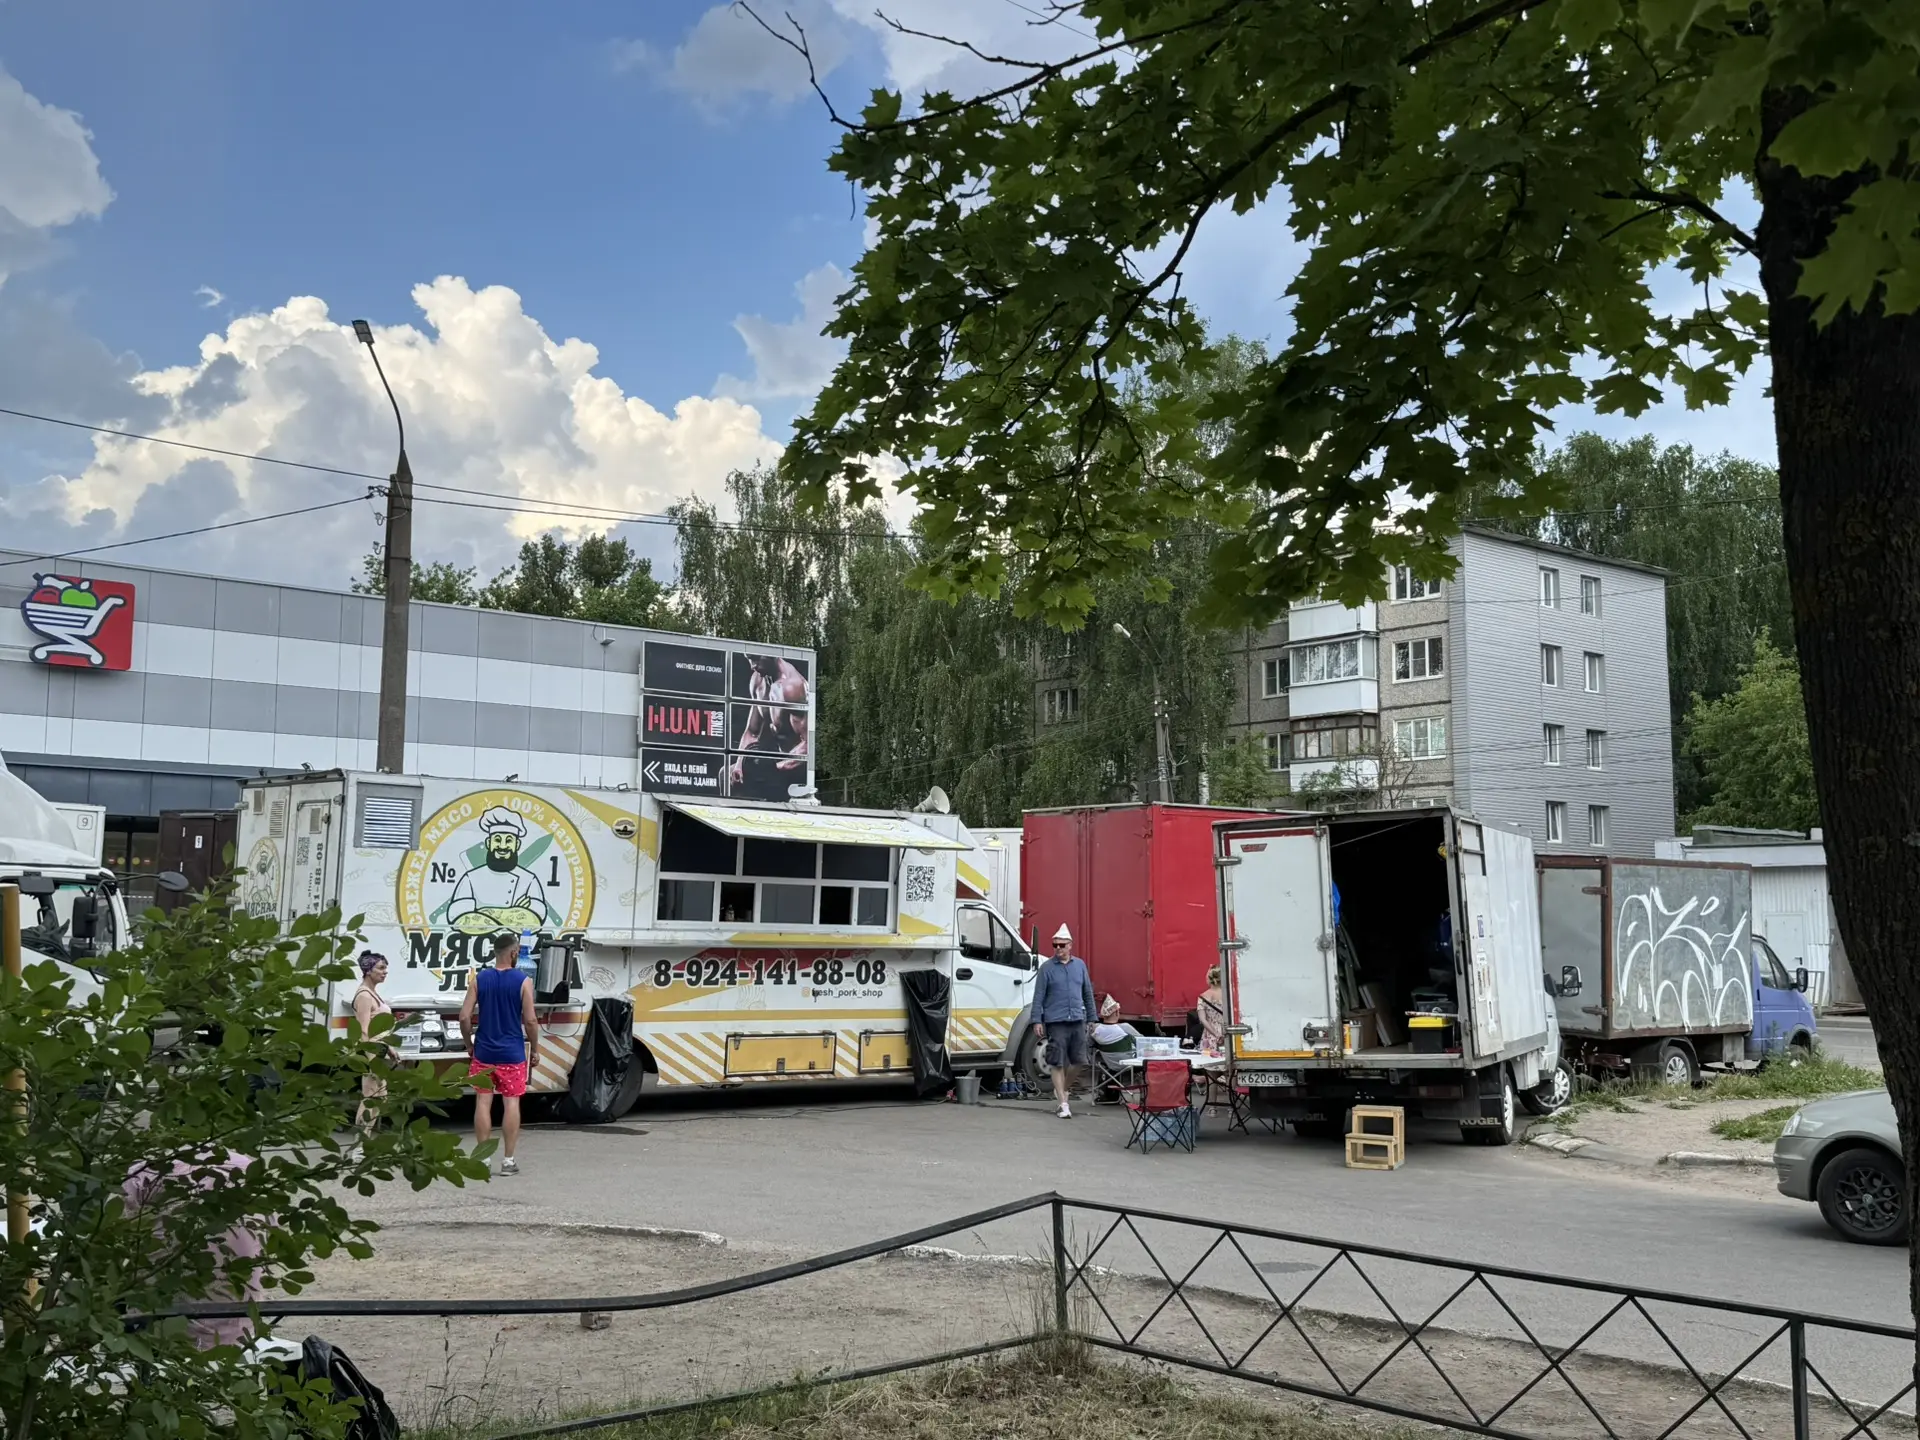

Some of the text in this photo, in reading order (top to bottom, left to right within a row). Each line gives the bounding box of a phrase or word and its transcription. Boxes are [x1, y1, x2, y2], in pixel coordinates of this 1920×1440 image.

[706, 665, 722, 673] СВОИХ
[664, 763, 708, 774] ВХОД С ЛЕВОЙ
[664, 775, 717, 787] СТОРОНЫ ЗДАНИЯ
[501, 795, 546, 822] 100%
[425, 803, 473, 845] МЯСО
[547, 856, 561, 887] 1
[407, 932, 585, 968] МЯСАЯ
[654, 959, 886, 987] 8-924-141-88-08
[812, 987, 883, 998] fesh_pork_shop
